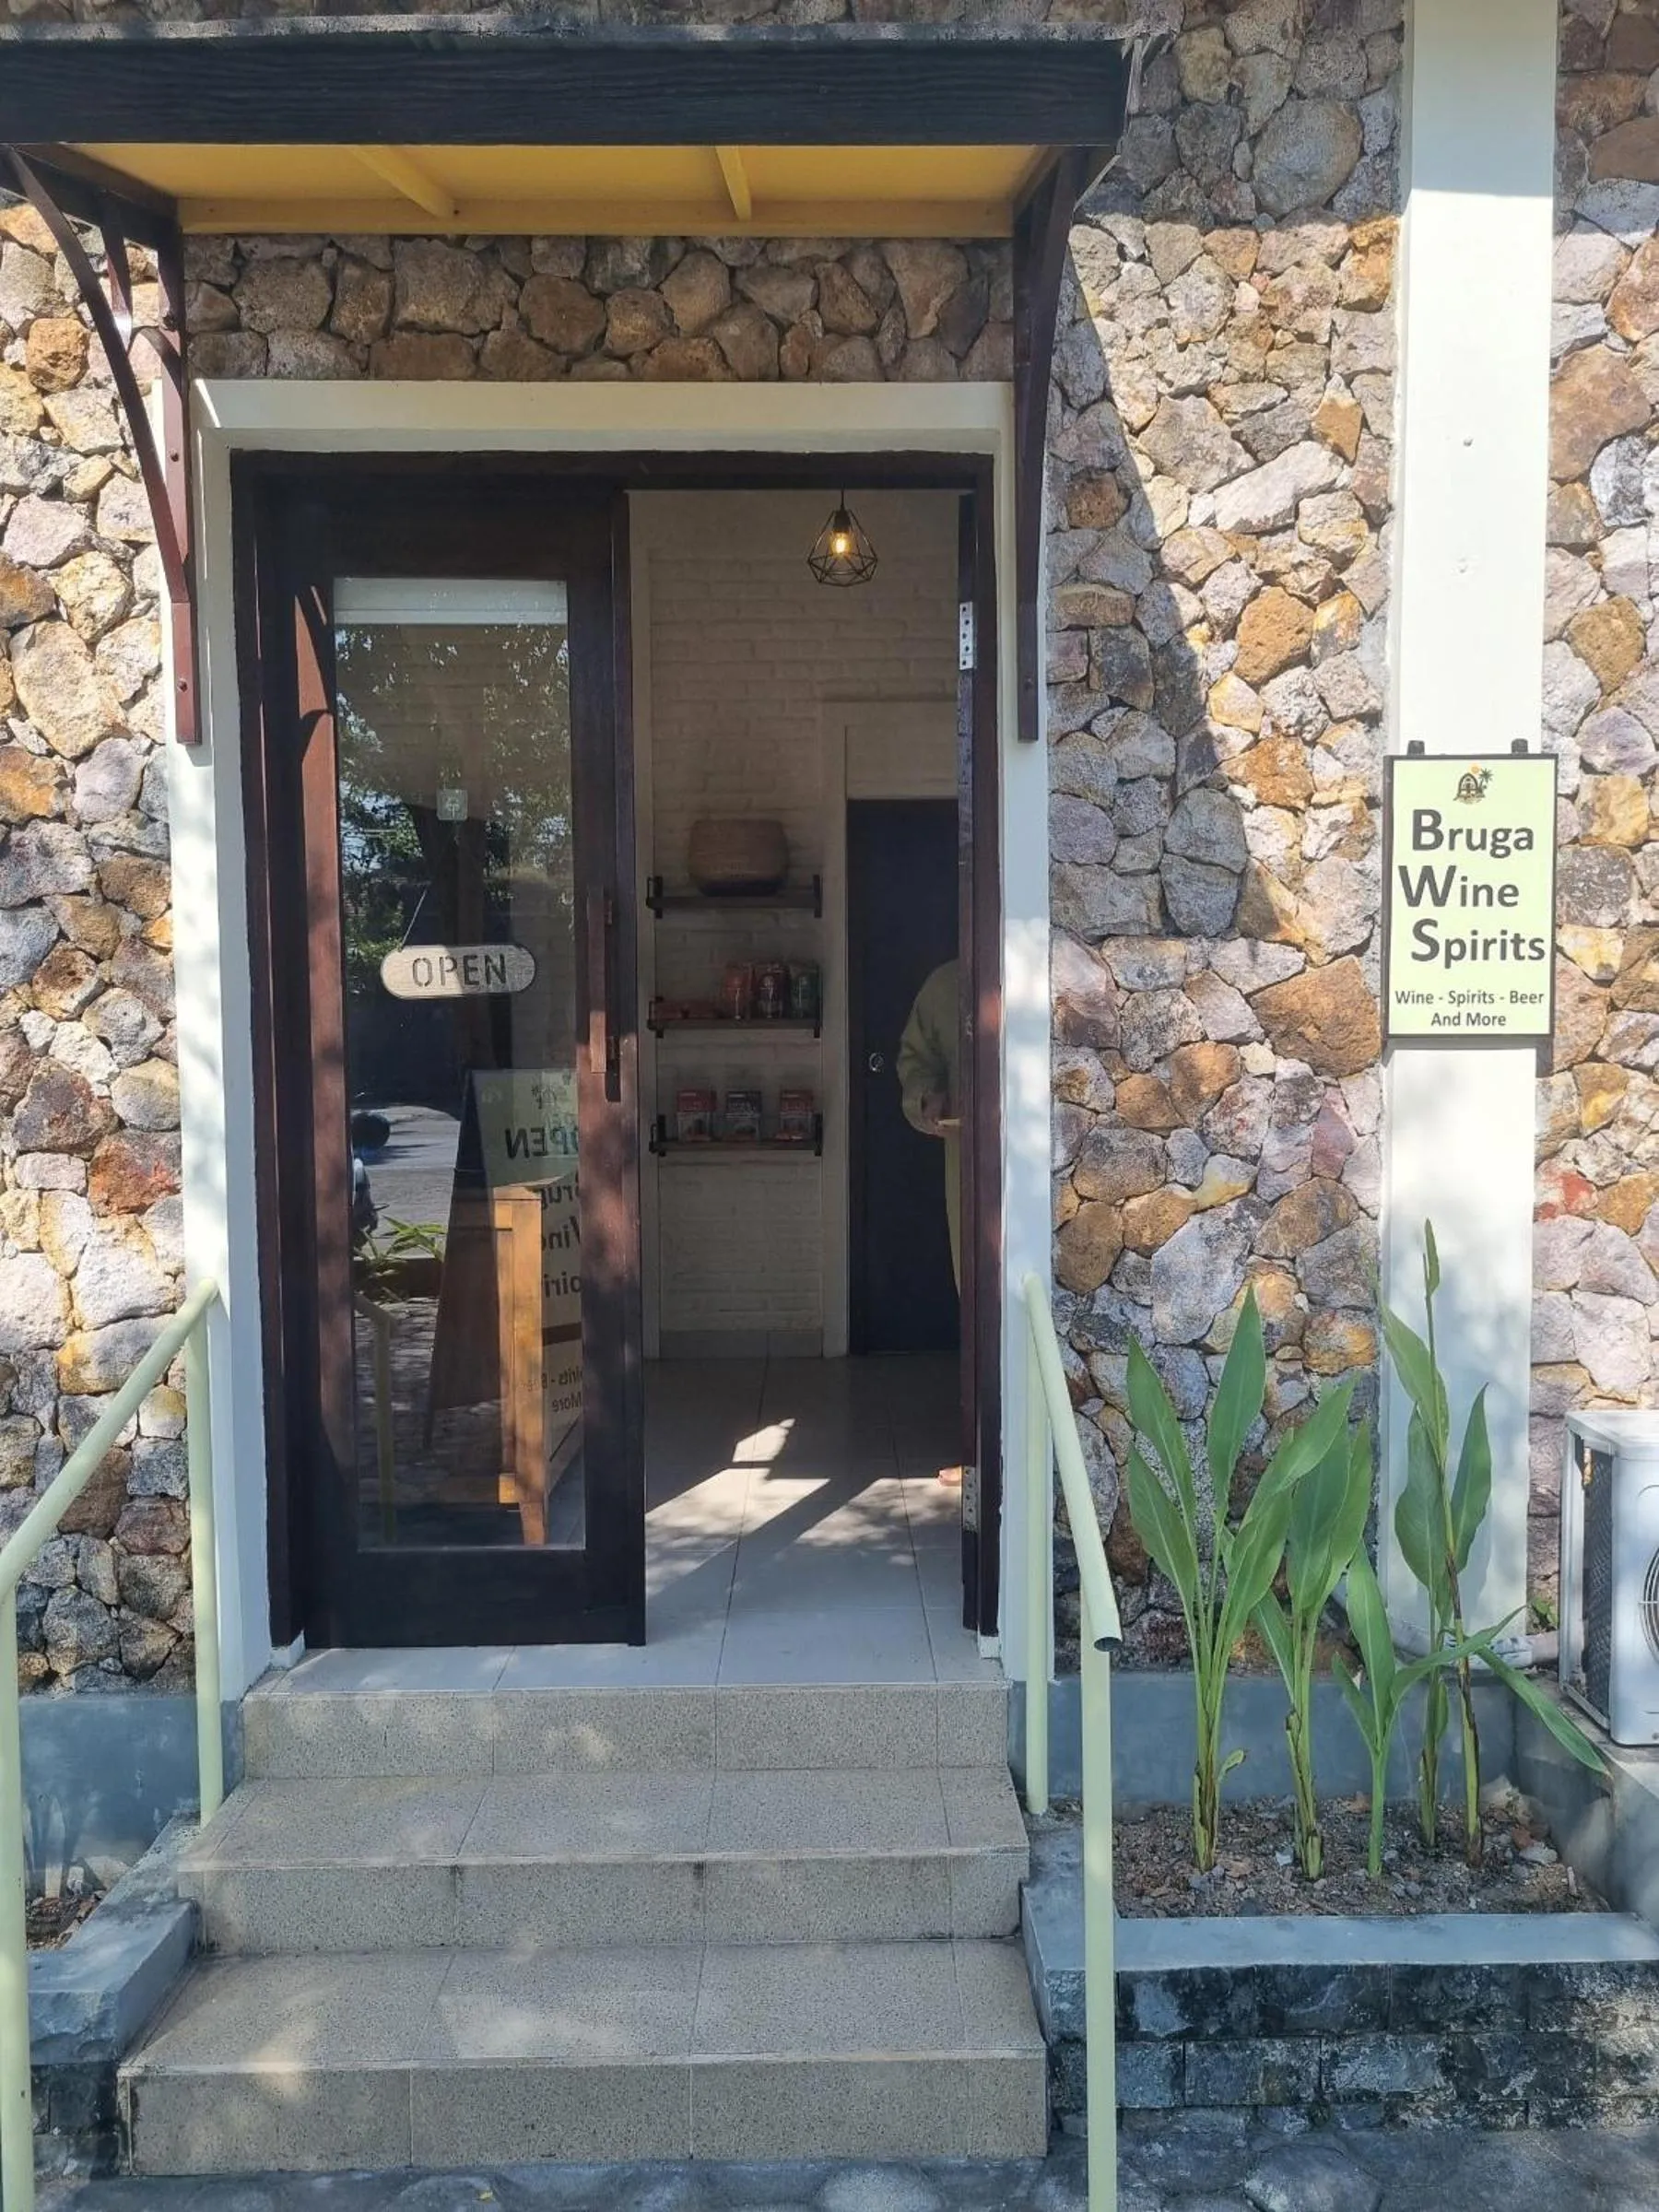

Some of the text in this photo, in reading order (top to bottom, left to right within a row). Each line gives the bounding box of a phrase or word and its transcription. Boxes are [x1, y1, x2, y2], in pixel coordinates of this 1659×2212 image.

[1412, 808, 1535, 859] Bruga
[1397, 865, 1520, 908] Wine
[1411, 918, 1546, 970] Spirits
[412, 954, 506, 987] OPEN
[1394, 990, 1434, 1005] Wine
[1448, 990, 1495, 1007] Spirits
[1509, 990, 1544, 1005] Beer
[1430, 1011, 1507, 1027] And More
